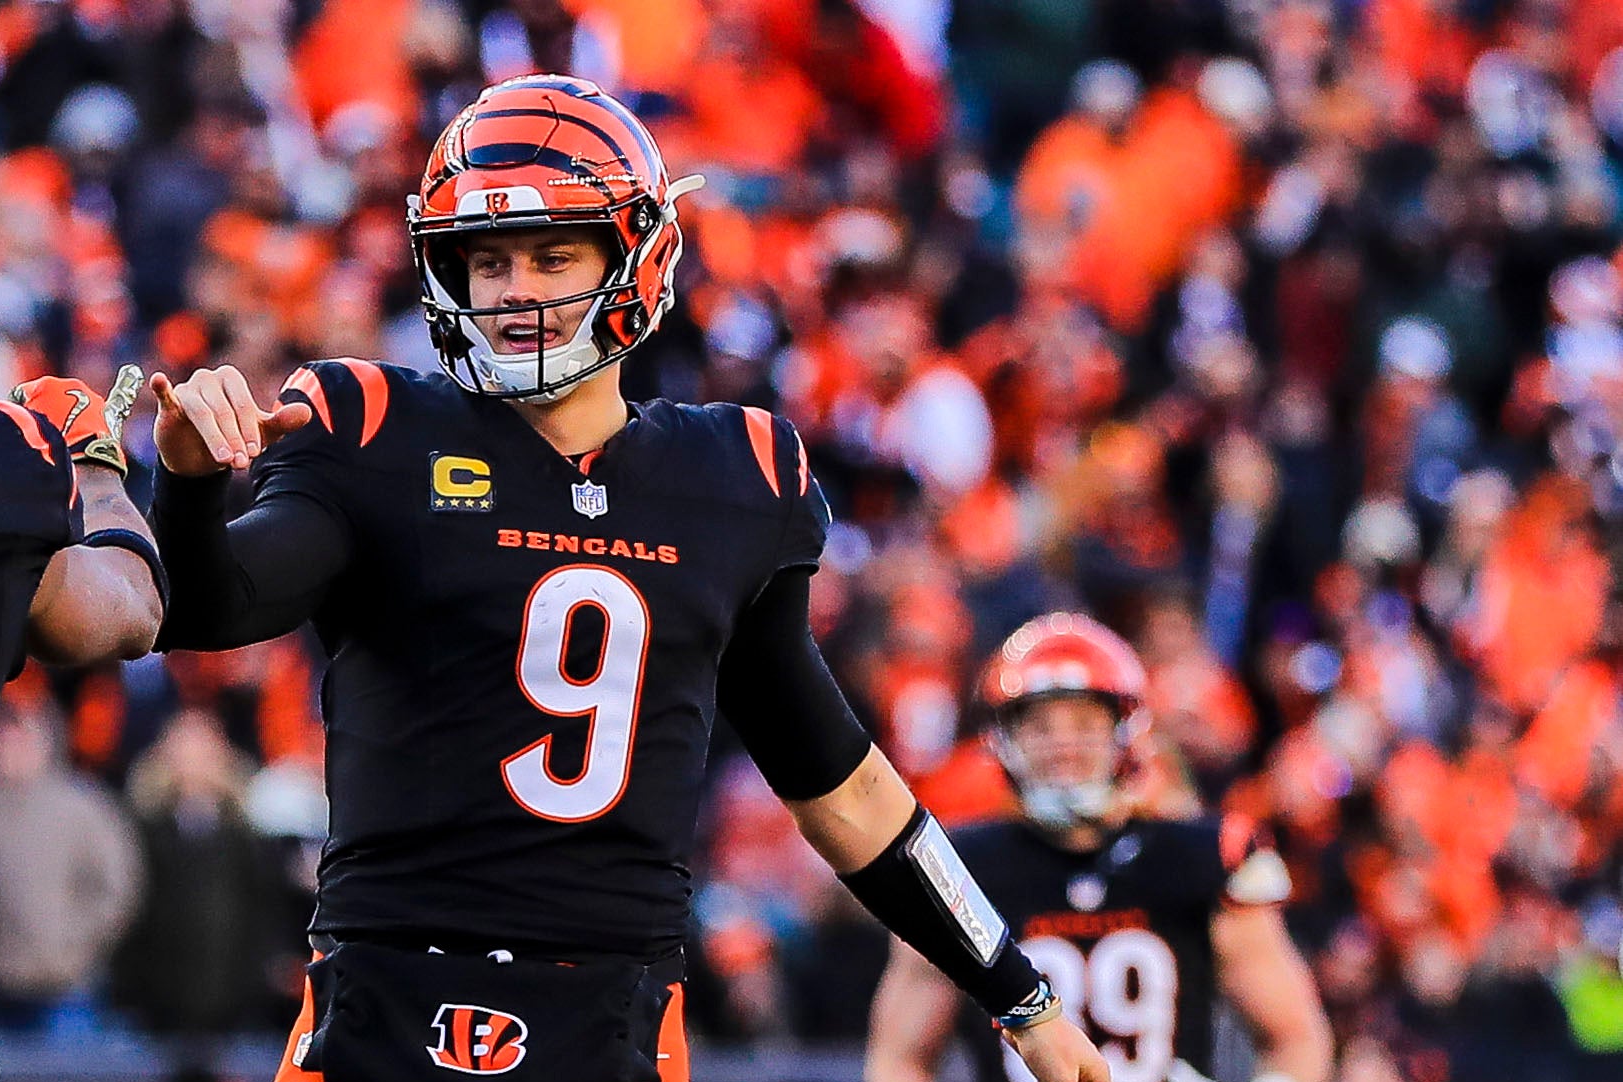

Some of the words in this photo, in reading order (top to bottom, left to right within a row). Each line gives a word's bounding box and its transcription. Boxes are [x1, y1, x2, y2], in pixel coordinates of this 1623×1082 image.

[432, 455, 492, 498] C
[579, 496, 602, 510] NFL
[497, 529, 679, 564] BENGALS
[500, 563, 652, 823] 9
